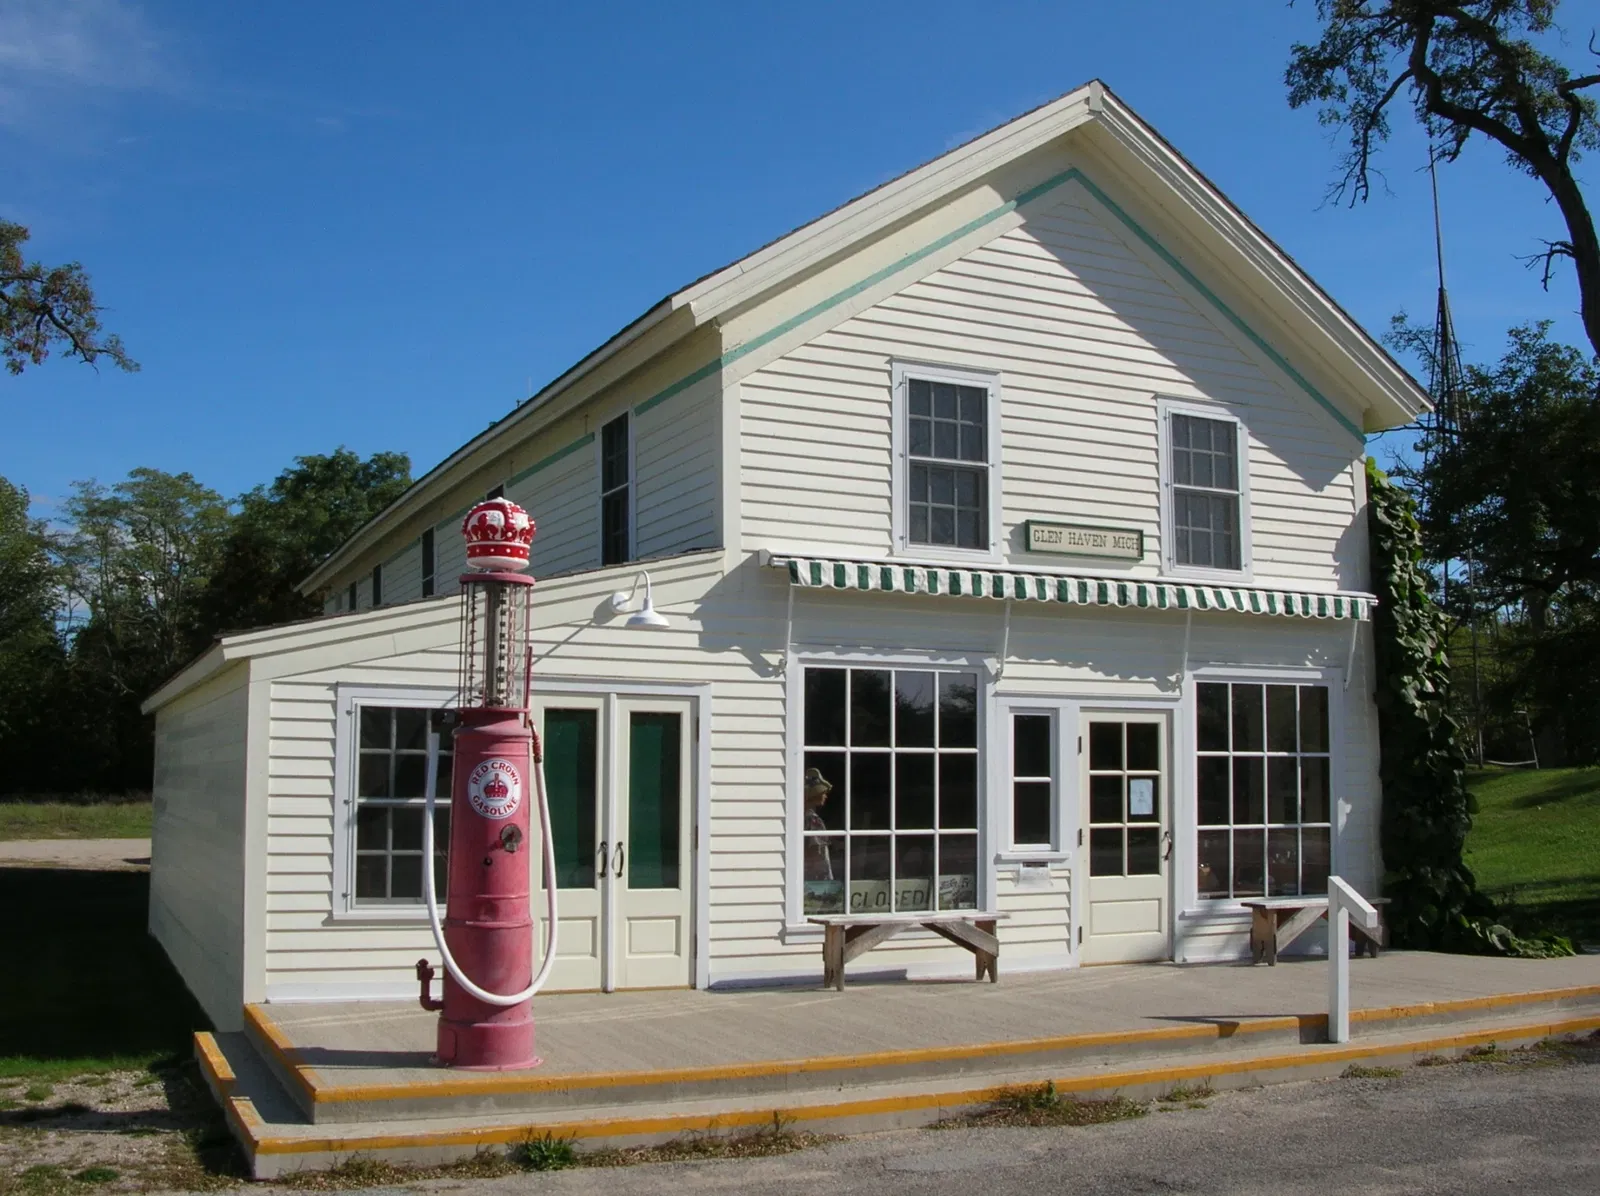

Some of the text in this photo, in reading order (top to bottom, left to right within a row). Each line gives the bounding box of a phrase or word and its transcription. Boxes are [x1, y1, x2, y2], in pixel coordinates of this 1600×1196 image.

[1033, 529, 1140, 551] GLEN HAVEN MICH
[472, 761, 519, 786] RED CROWN
[473, 795, 517, 816] GASOLINE
